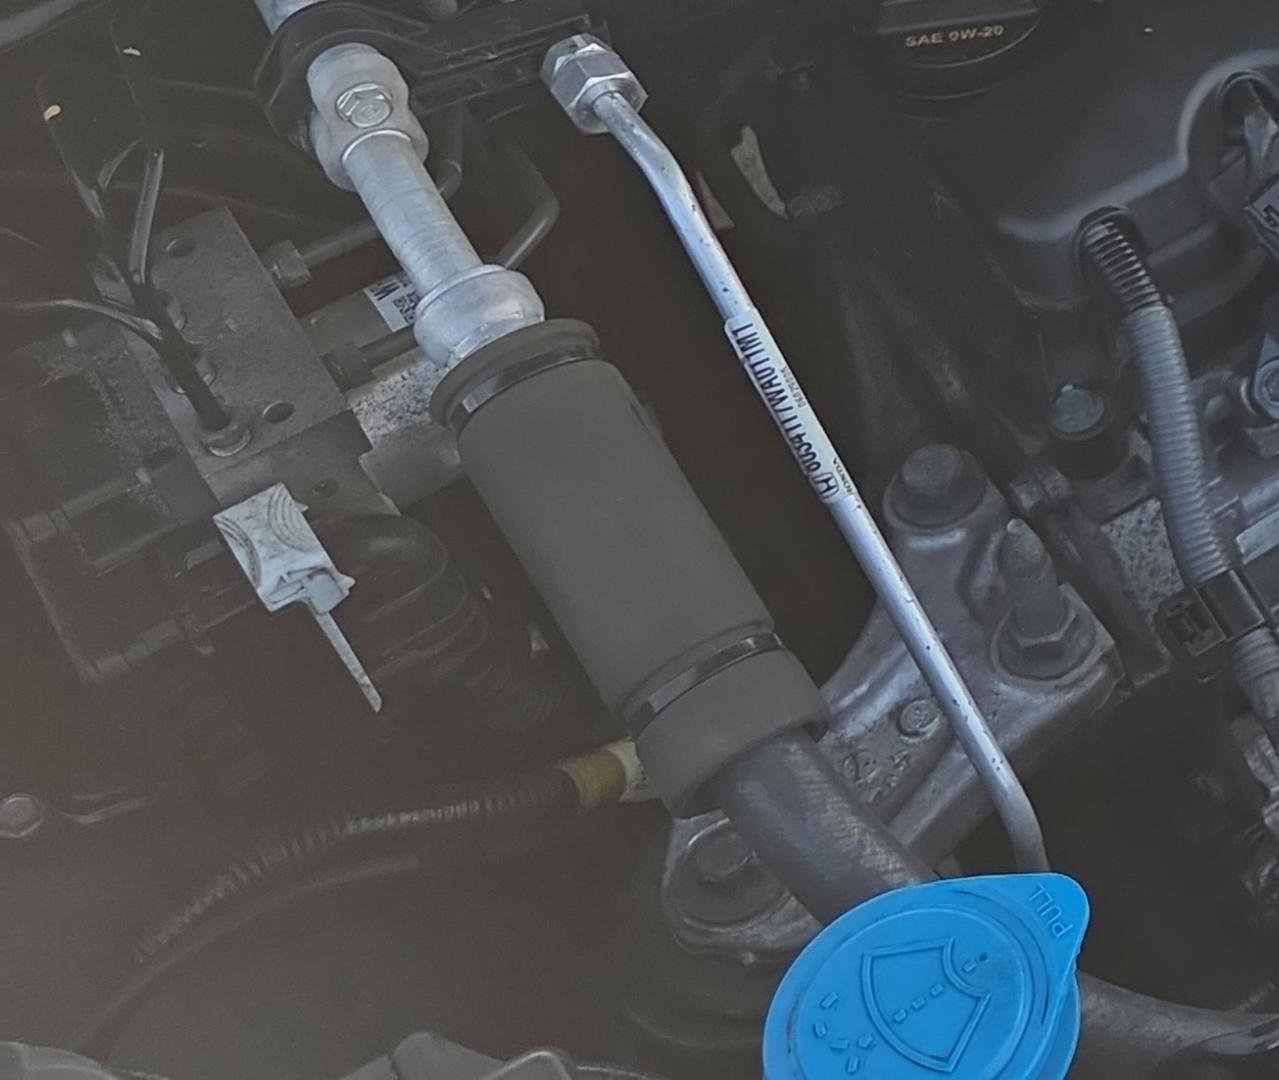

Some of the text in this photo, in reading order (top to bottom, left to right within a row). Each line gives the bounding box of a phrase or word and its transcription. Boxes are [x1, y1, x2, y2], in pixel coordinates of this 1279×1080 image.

[904, 24, 1004, 48] SAE 0W-20
[1027, 883, 1073, 940] PULL
